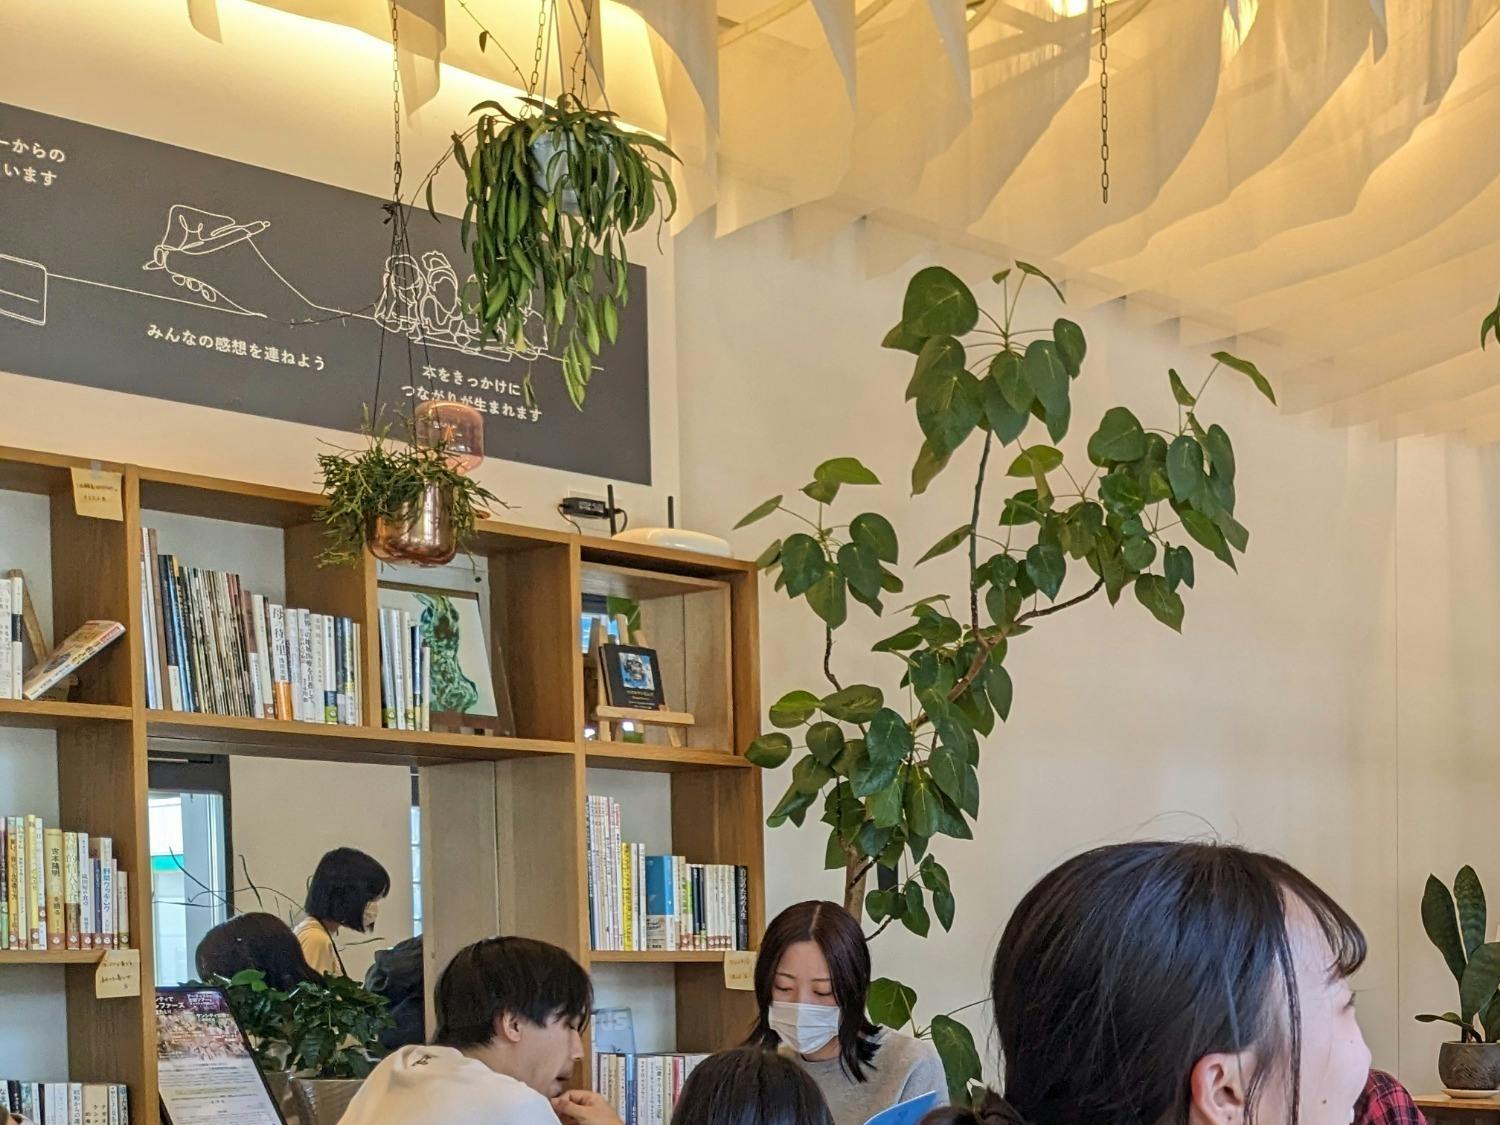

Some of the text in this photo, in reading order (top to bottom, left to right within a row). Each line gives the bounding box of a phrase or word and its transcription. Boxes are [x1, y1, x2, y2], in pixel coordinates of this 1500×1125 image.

[147, 324, 326, 371] みんなの感想を連ねよう
[422, 363, 522, 396] 本をきっかけに
